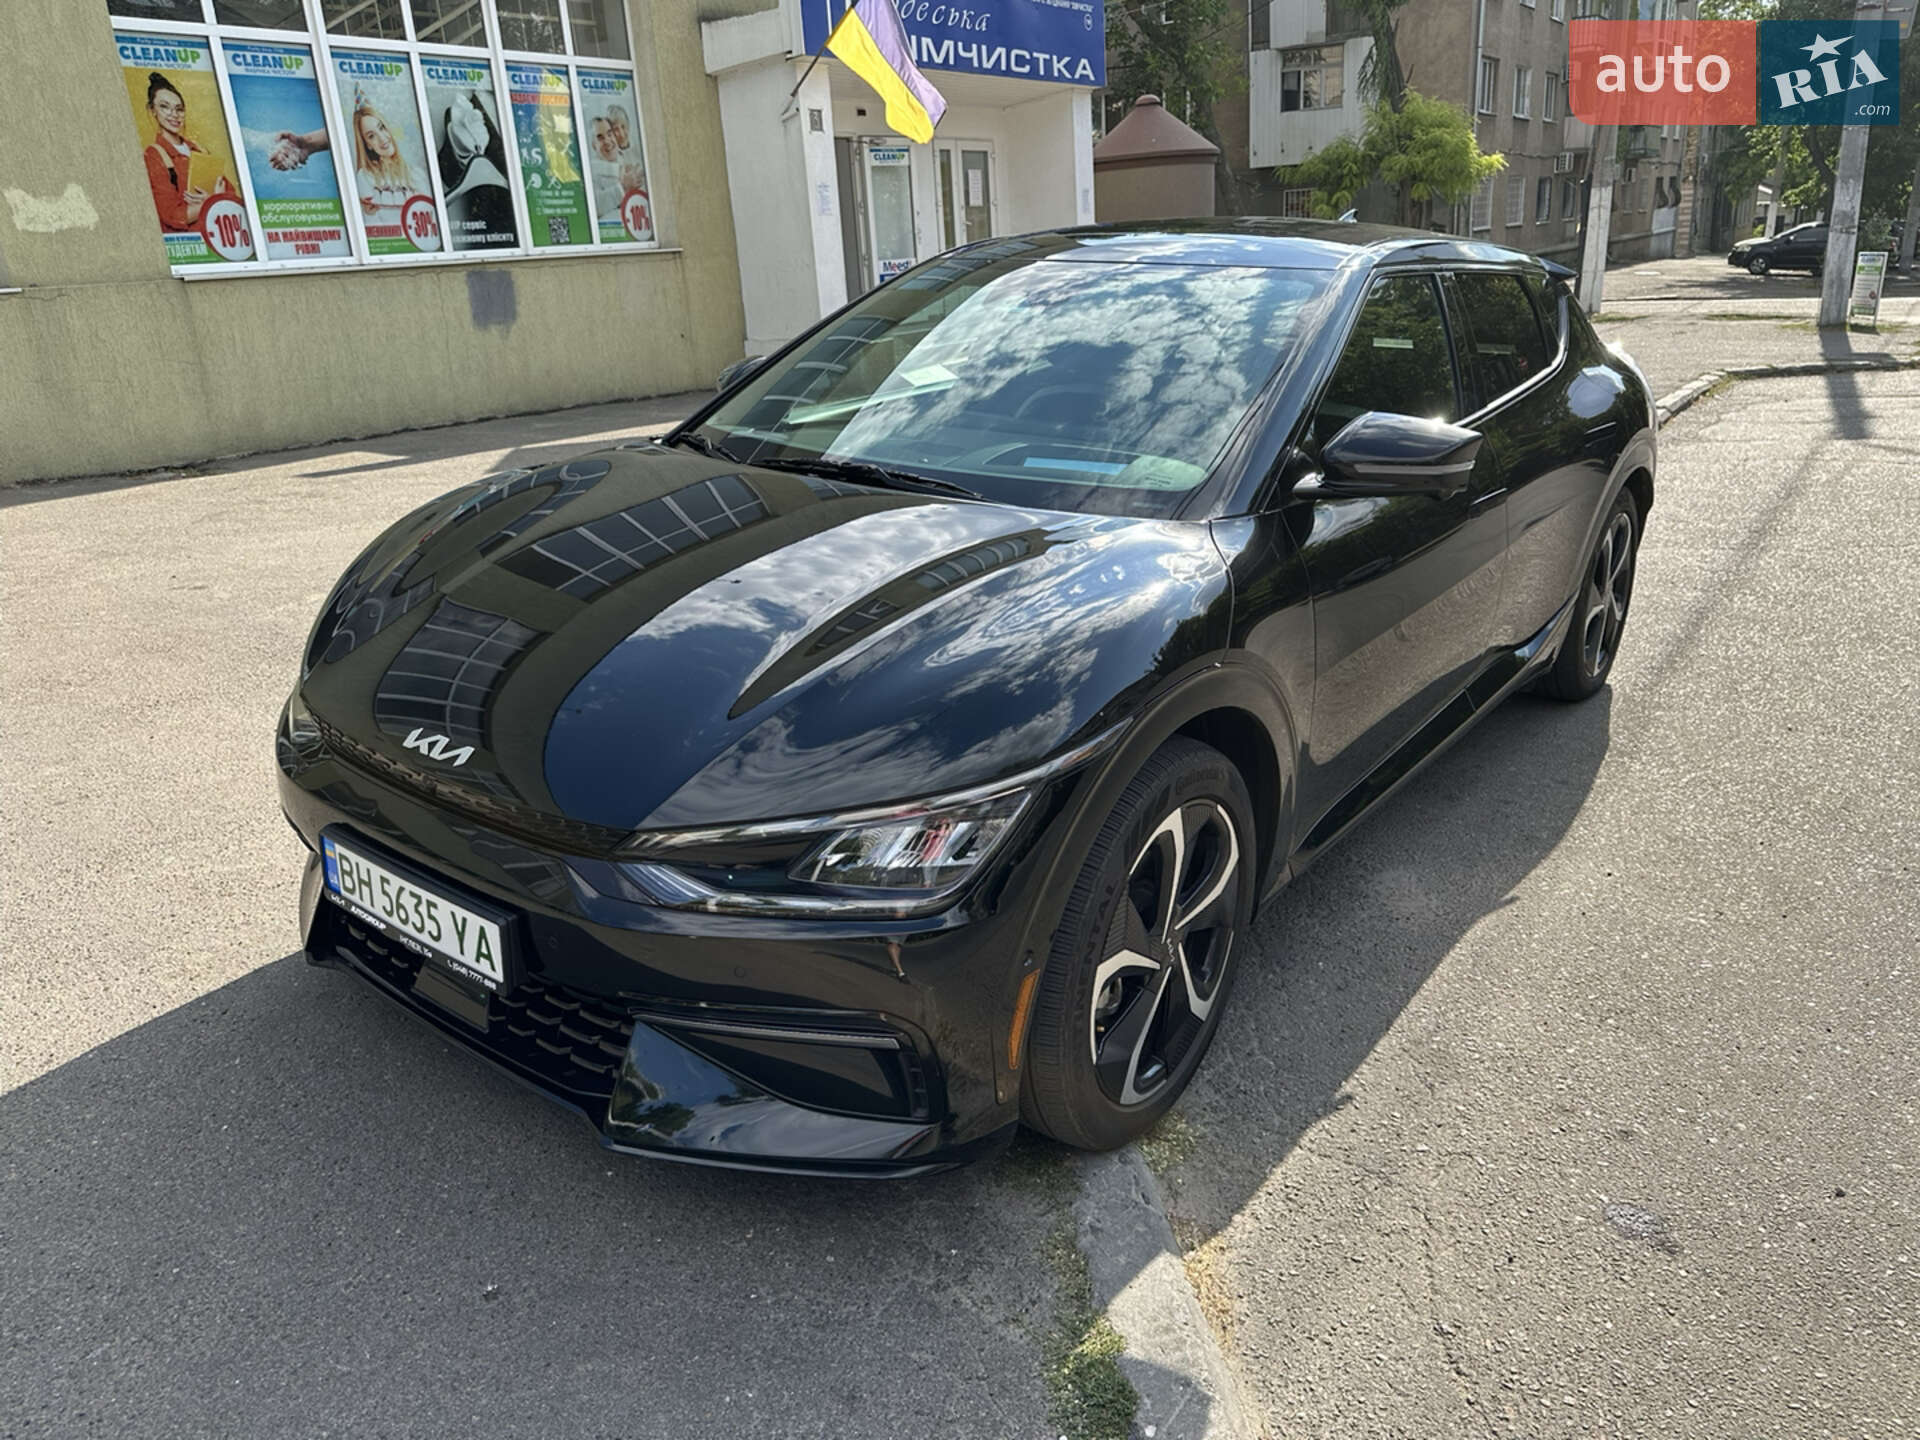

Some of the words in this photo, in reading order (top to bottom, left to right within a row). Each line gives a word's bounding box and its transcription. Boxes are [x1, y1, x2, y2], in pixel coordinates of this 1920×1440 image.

[895, 0, 991, 31] деська
[119, 45, 201, 64] CLEANUP
[231, 53, 304, 70] CLEANUP
[911, 35, 1095, 81] ІМЧИСТКА
[339, 60, 403, 77] CLEANUP
[427, 67, 484, 82] CLEANUP
[581, 78, 628, 91] CLEANUP
[873, 153, 905, 161] CLEANUP
[263, 202, 334, 213] корпоративне
[261, 213, 341, 225] обслуговування
[267, 231, 281, 243] НА
[282, 229, 341, 244] НАЙВИЩОМУ
[165, 243, 209, 258] ТУДЕНТАМ
[295, 243, 321, 255] РІВНІ
[338, 852, 374, 908] BH
[380, 875, 441, 942] 5635
[451, 910, 497, 973] YA
